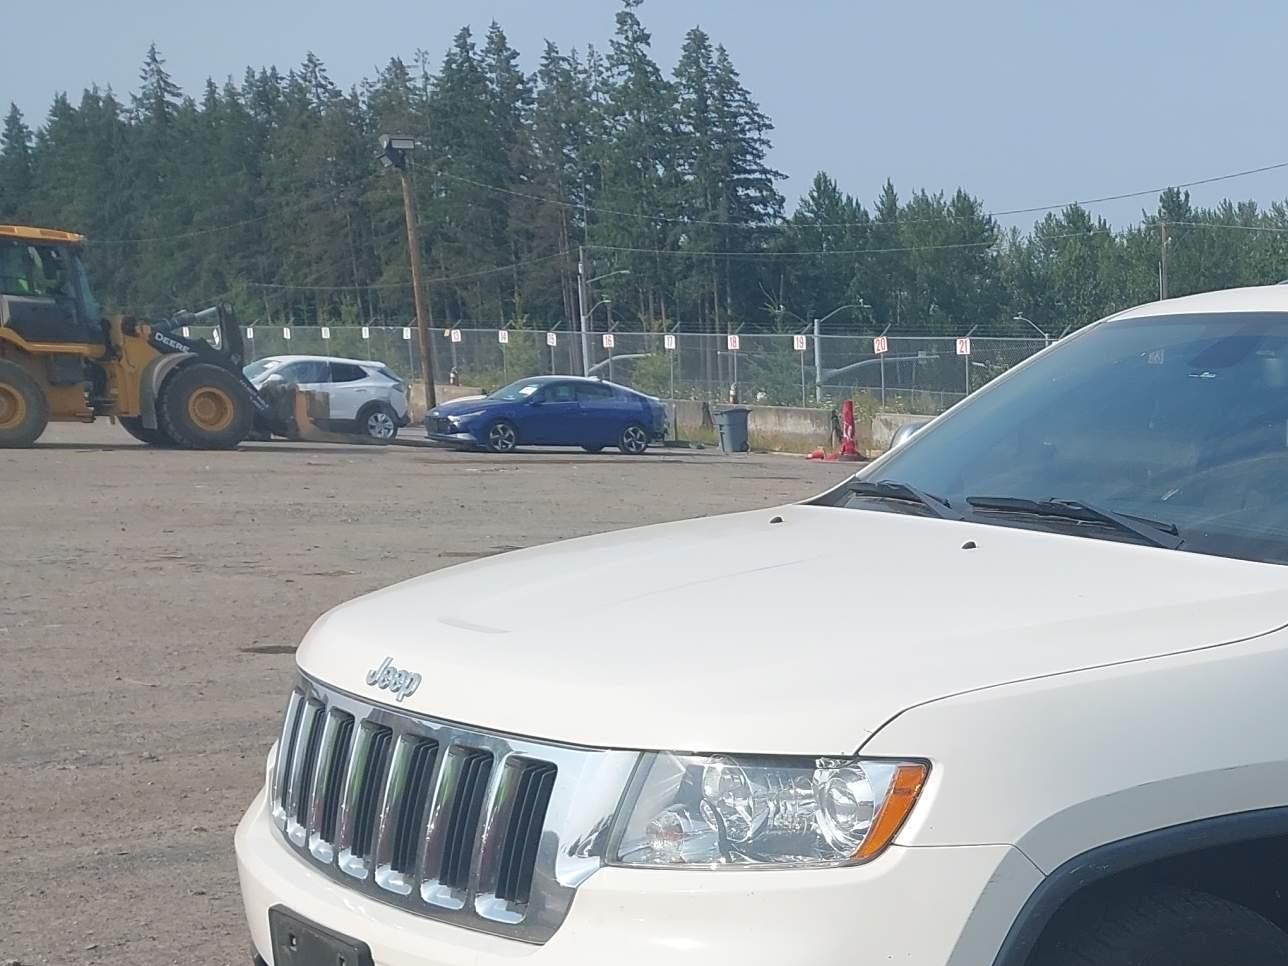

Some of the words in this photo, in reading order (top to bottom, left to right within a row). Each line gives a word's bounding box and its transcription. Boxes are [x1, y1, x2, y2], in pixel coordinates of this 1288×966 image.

[154, 332, 191, 354] DEERE
[729, 335, 738, 349] 18
[796, 335, 805, 349] 19
[875, 338, 886, 352] 20
[959, 339, 969, 354] 21
[366, 656, 423, 703] Jeep
